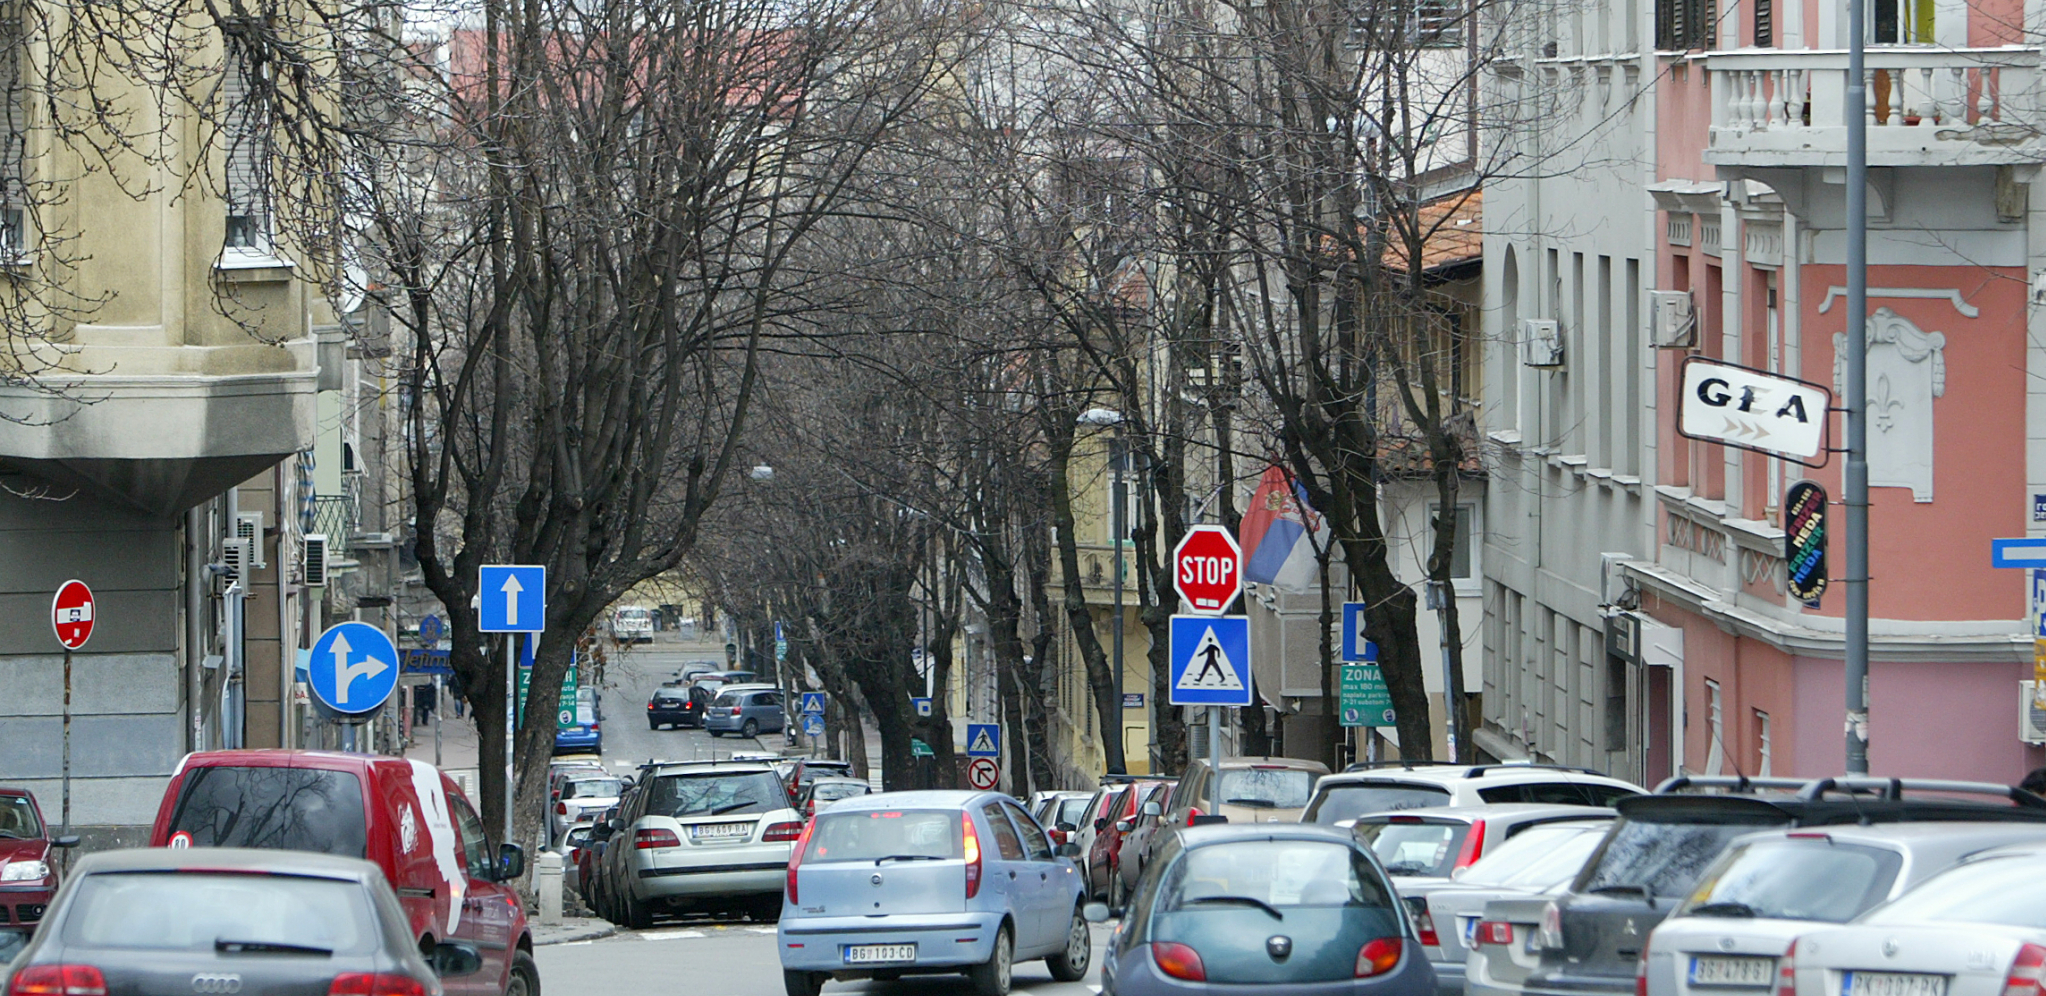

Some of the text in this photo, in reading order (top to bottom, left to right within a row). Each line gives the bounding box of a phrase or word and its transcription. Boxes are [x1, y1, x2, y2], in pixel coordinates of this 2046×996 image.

[1697, 377, 1808, 423] GEA
[1788, 491, 1822, 537] FRIZER
[1788, 526, 1824, 573] FRIZER
[1181, 555, 1234, 585] STOP
[1345, 669, 1382, 681] ZONA
[852, 948, 866, 960] BG
